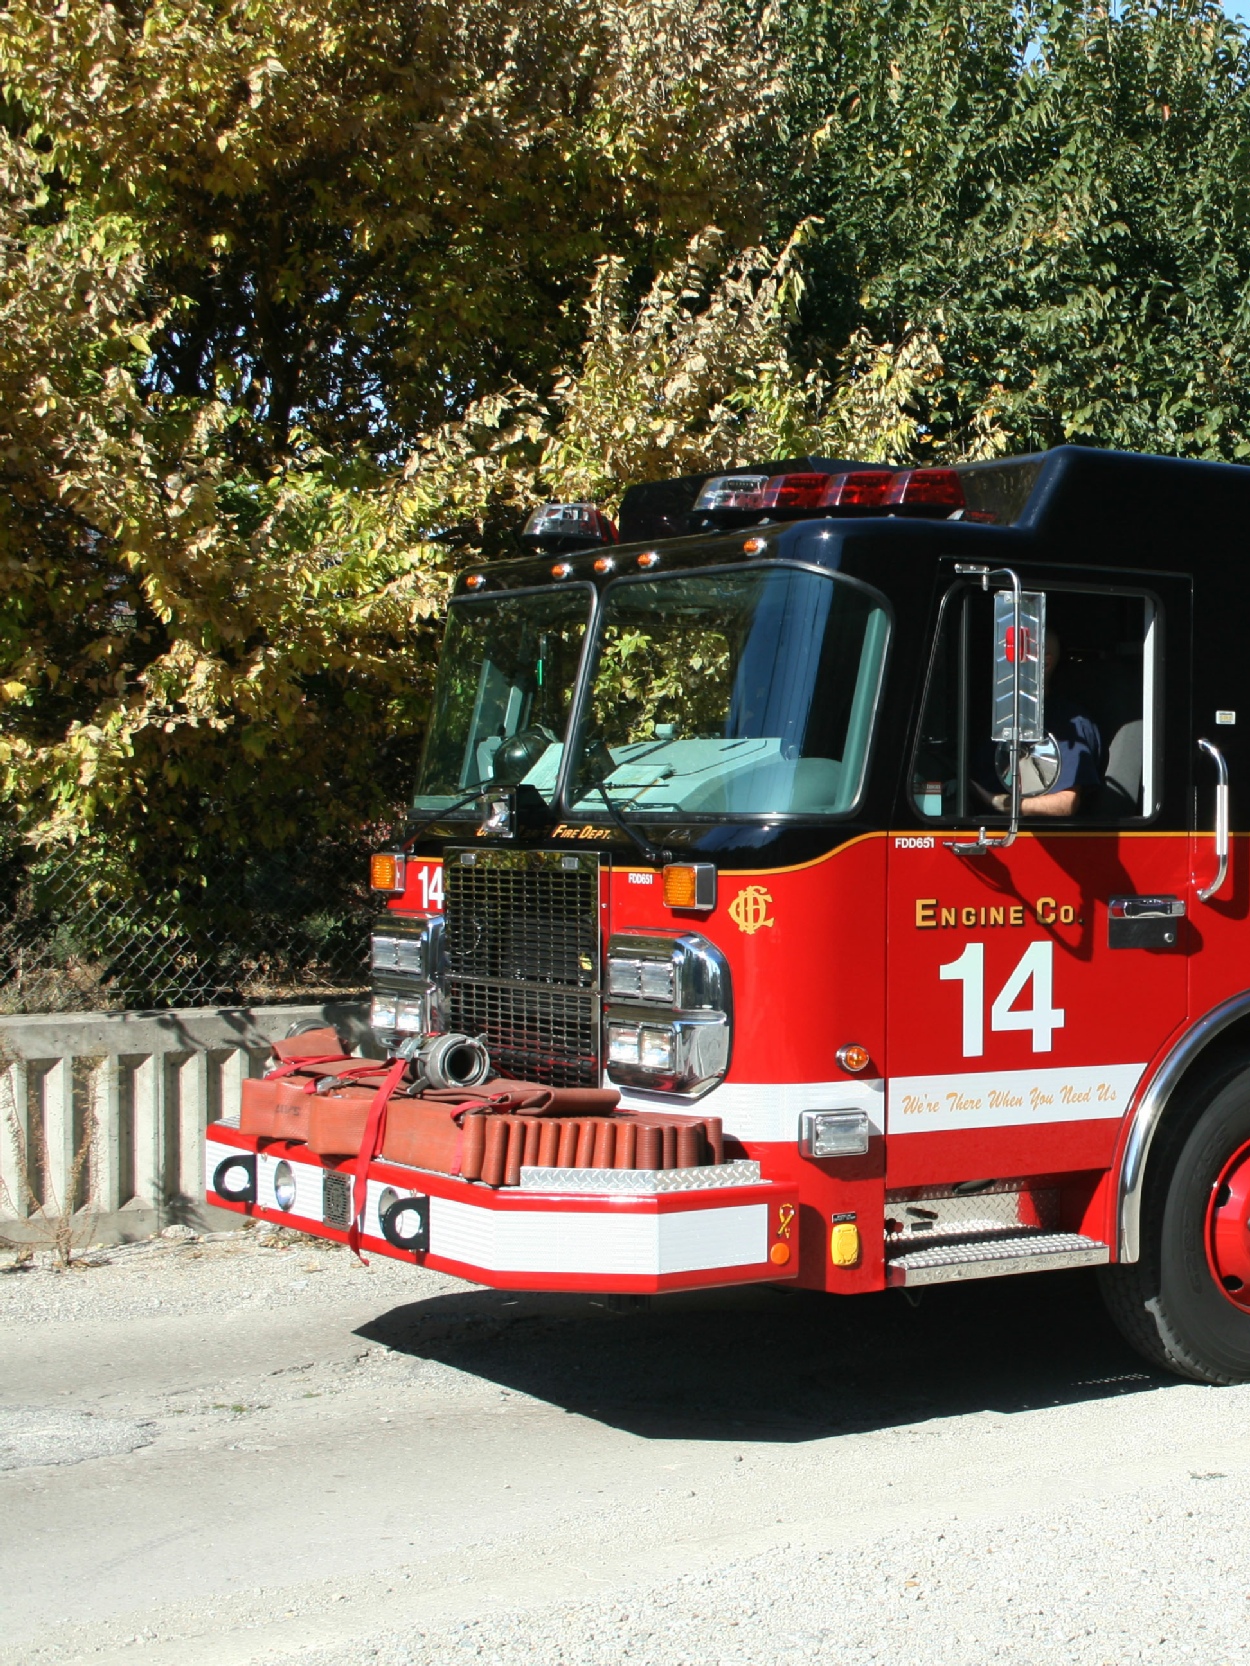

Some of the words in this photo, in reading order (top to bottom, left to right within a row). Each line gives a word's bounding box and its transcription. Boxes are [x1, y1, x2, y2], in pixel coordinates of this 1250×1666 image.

[552, 824, 580, 839] FIRE
[895, 837, 935, 849] FDD651
[418, 866, 445, 909] 14
[628, 873, 653, 885] FDD651
[915, 898, 1025, 929] ENGINE
[939, 940, 1065, 1058] 14
[902, 1093, 940, 1115] We're
[946, 1091, 982, 1113] There
[987, 1089, 1023, 1109] When
[1029, 1086, 1055, 1112] You
[1060, 1084, 1092, 1105] Need
[1096, 1082, 1117, 1103] Us
